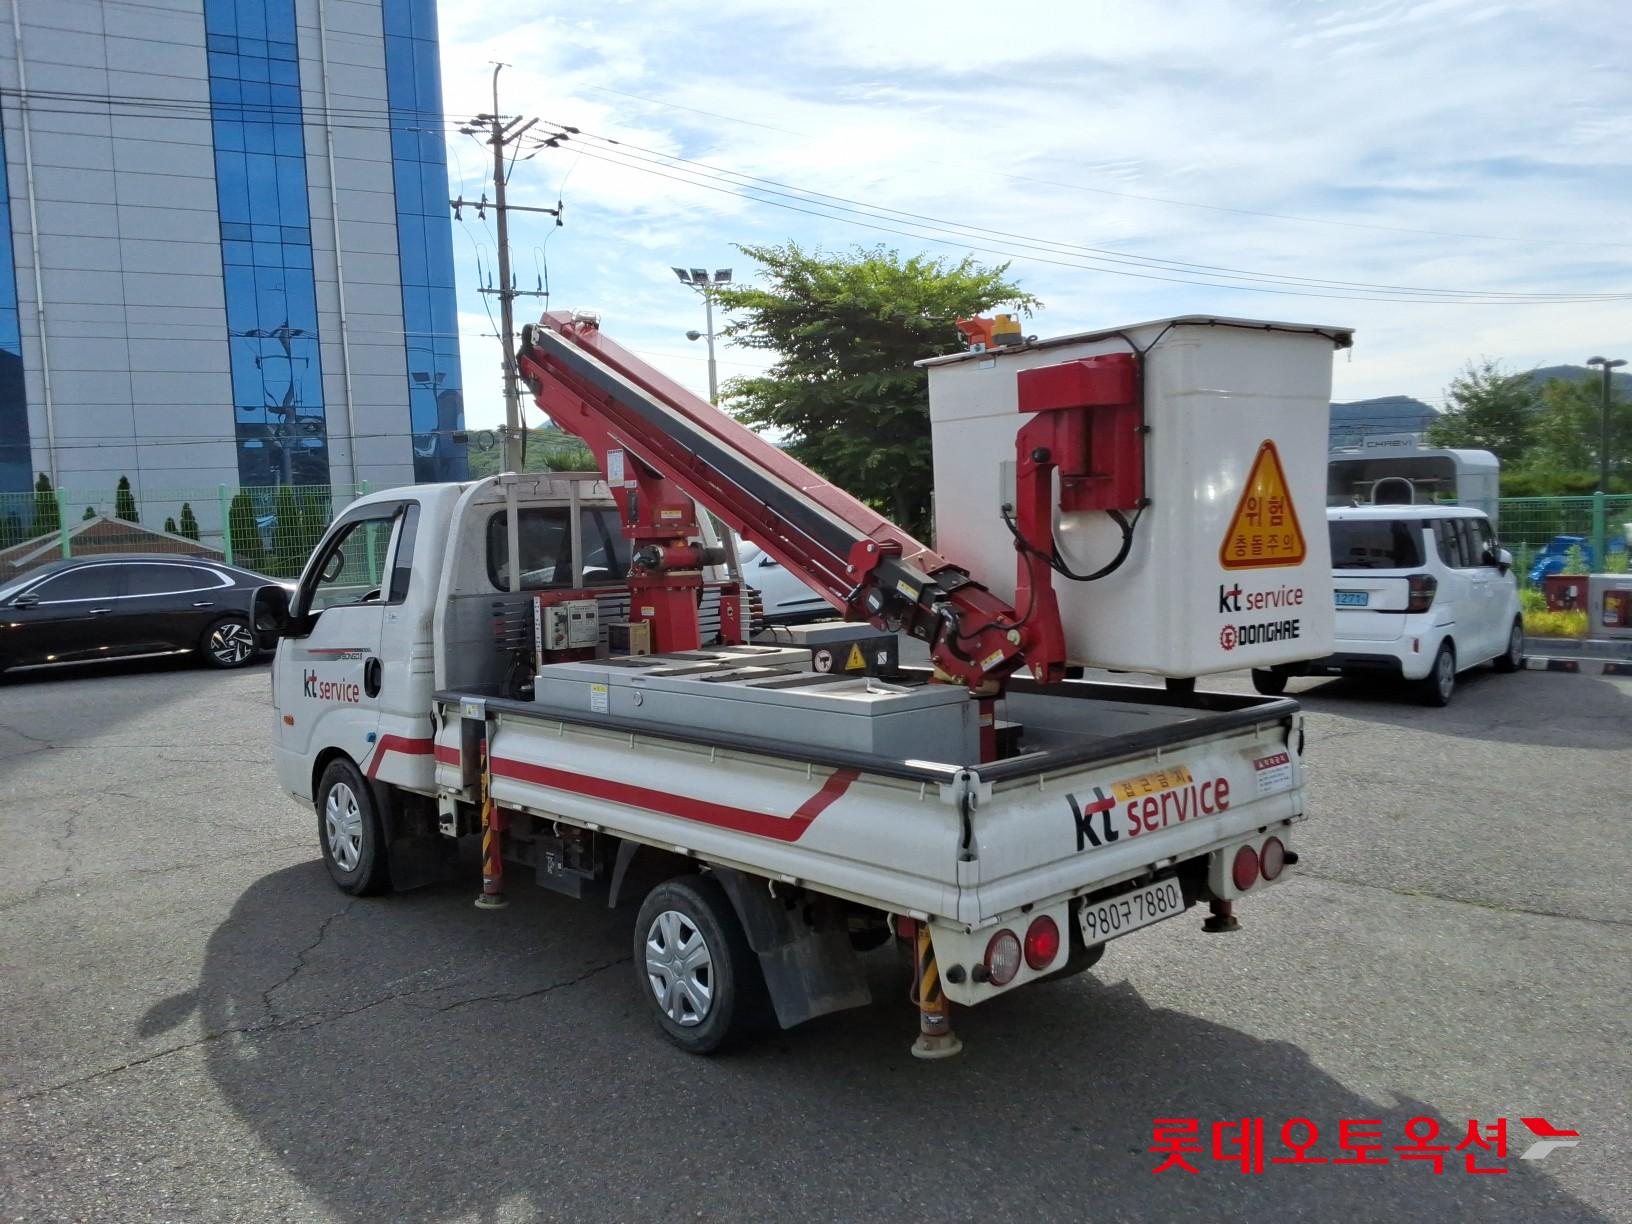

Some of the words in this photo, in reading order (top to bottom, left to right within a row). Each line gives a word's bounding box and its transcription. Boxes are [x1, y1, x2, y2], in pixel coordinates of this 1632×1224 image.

[1219, 583, 1242, 613] kt
[1246, 584, 1303, 611] service
[1238, 619, 1300, 646] DONGHAE
[303, 668, 318, 698] kt
[319, 677, 360, 703] service
[1065, 787, 1119, 851] kt
[1127, 777, 1230, 837] service
